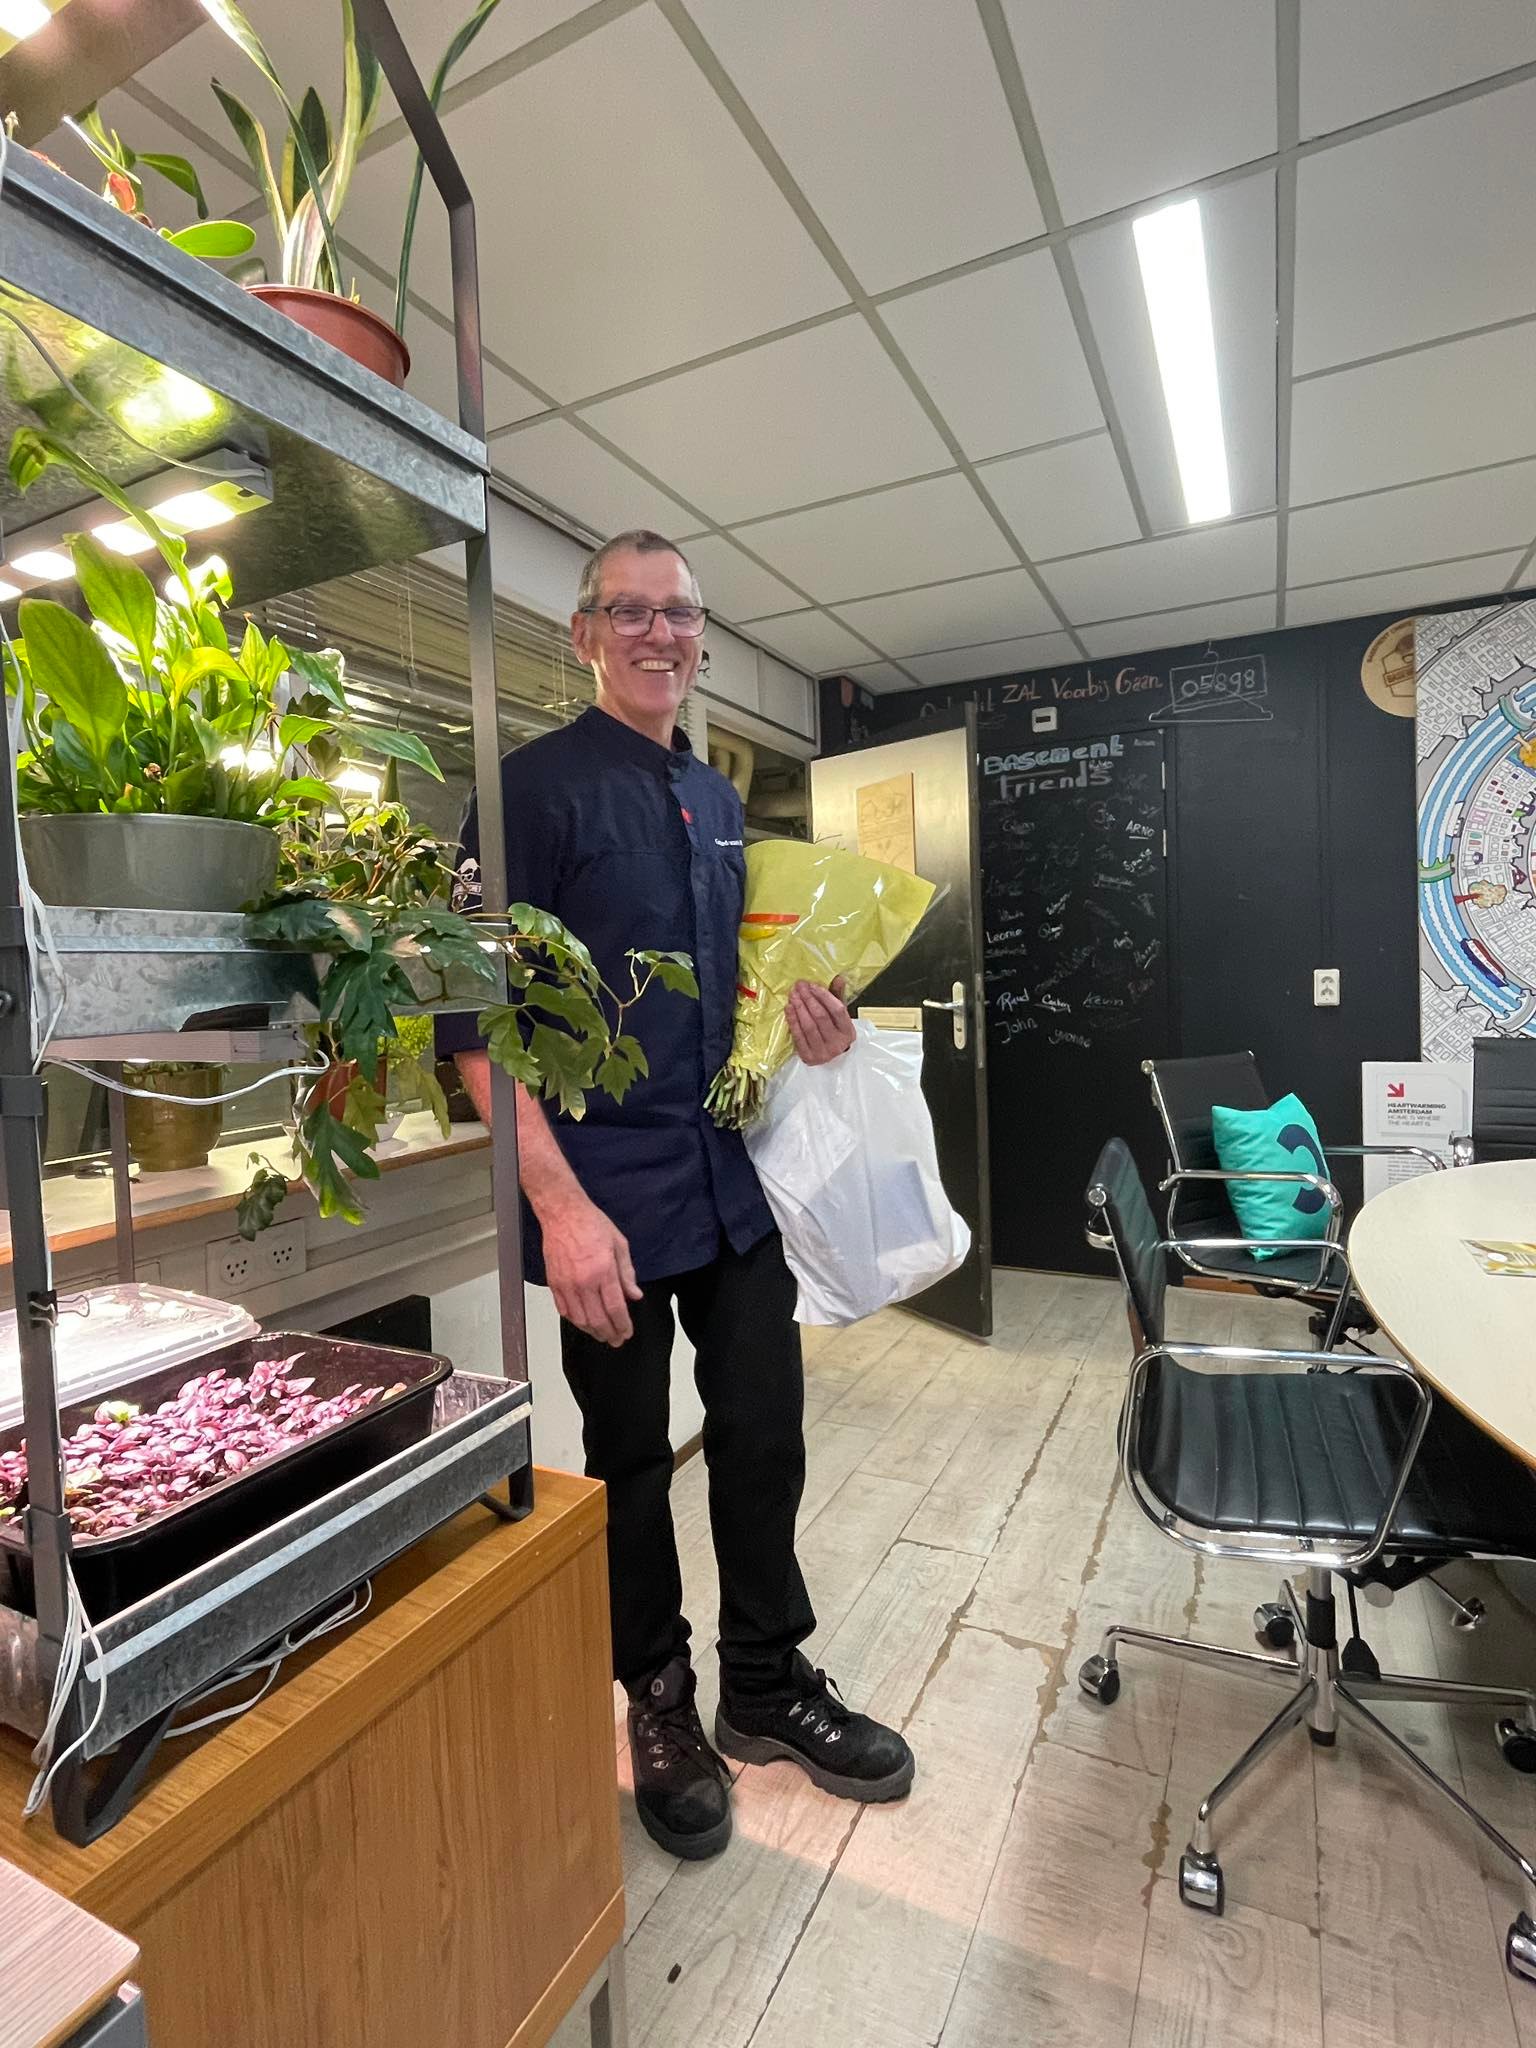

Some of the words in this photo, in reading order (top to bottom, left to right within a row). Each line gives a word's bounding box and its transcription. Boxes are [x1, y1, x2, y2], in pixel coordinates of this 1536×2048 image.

[1002, 679, 1042, 704] ZAL
[1115, 667, 1163, 695] Gaan
[1125, 819, 1155, 837] ARNO
